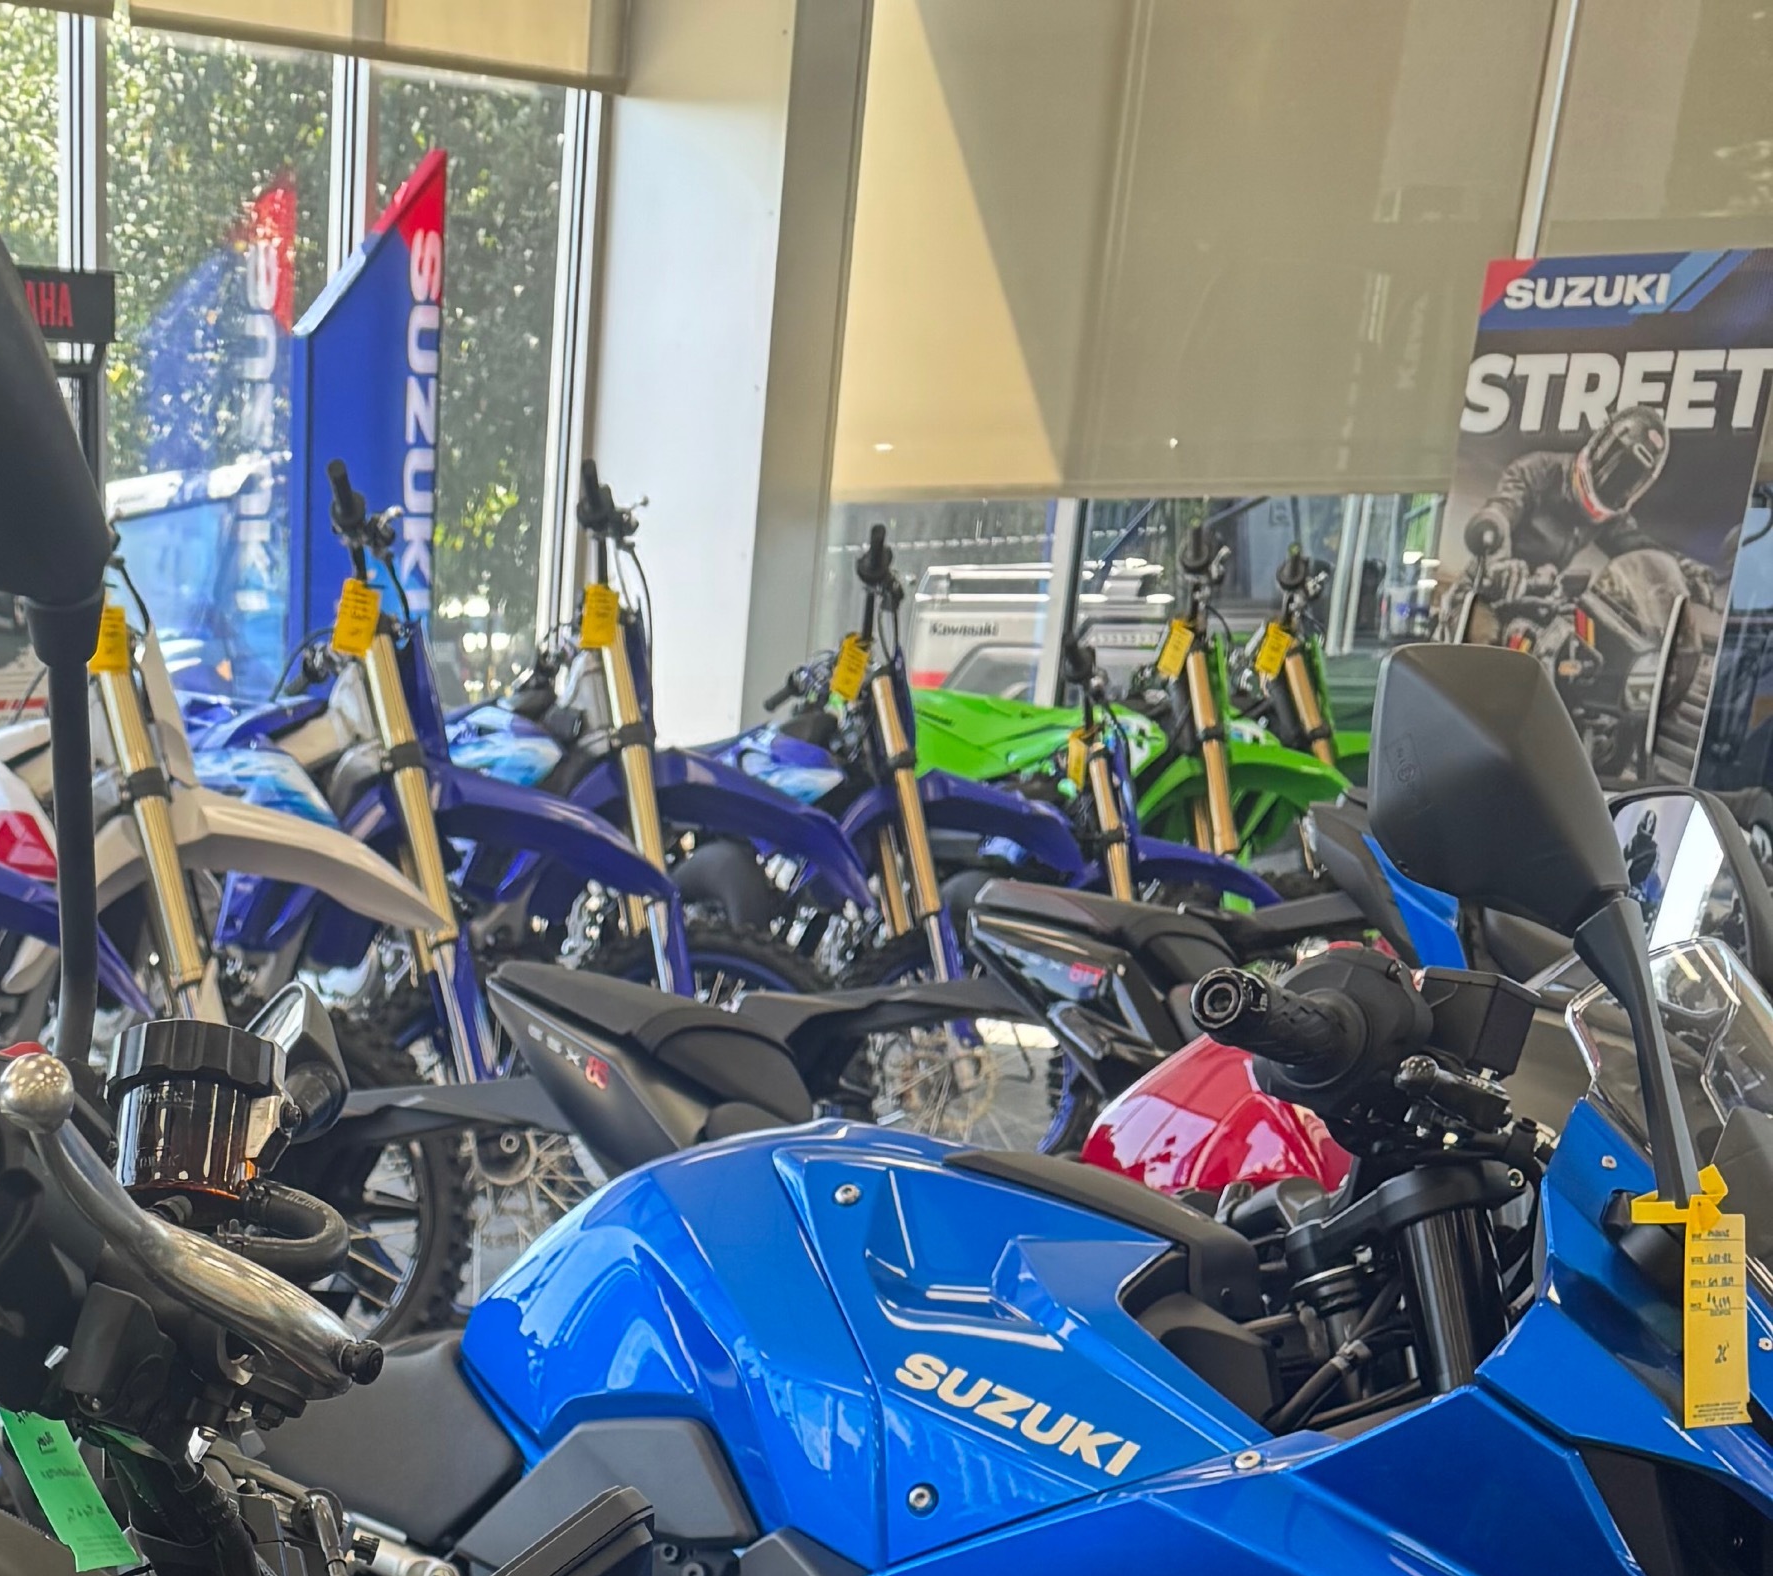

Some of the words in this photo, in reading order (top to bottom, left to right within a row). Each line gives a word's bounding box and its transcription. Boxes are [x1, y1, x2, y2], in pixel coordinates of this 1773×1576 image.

[1503, 272, 1671, 311] SUZUKI
[401, 229, 442, 611] SUZUKI
[1460, 347, 1773, 432] STREET
[928, 620, 1000, 639] Kawasaki
[894, 1353, 1141, 1476] SUZUKI
